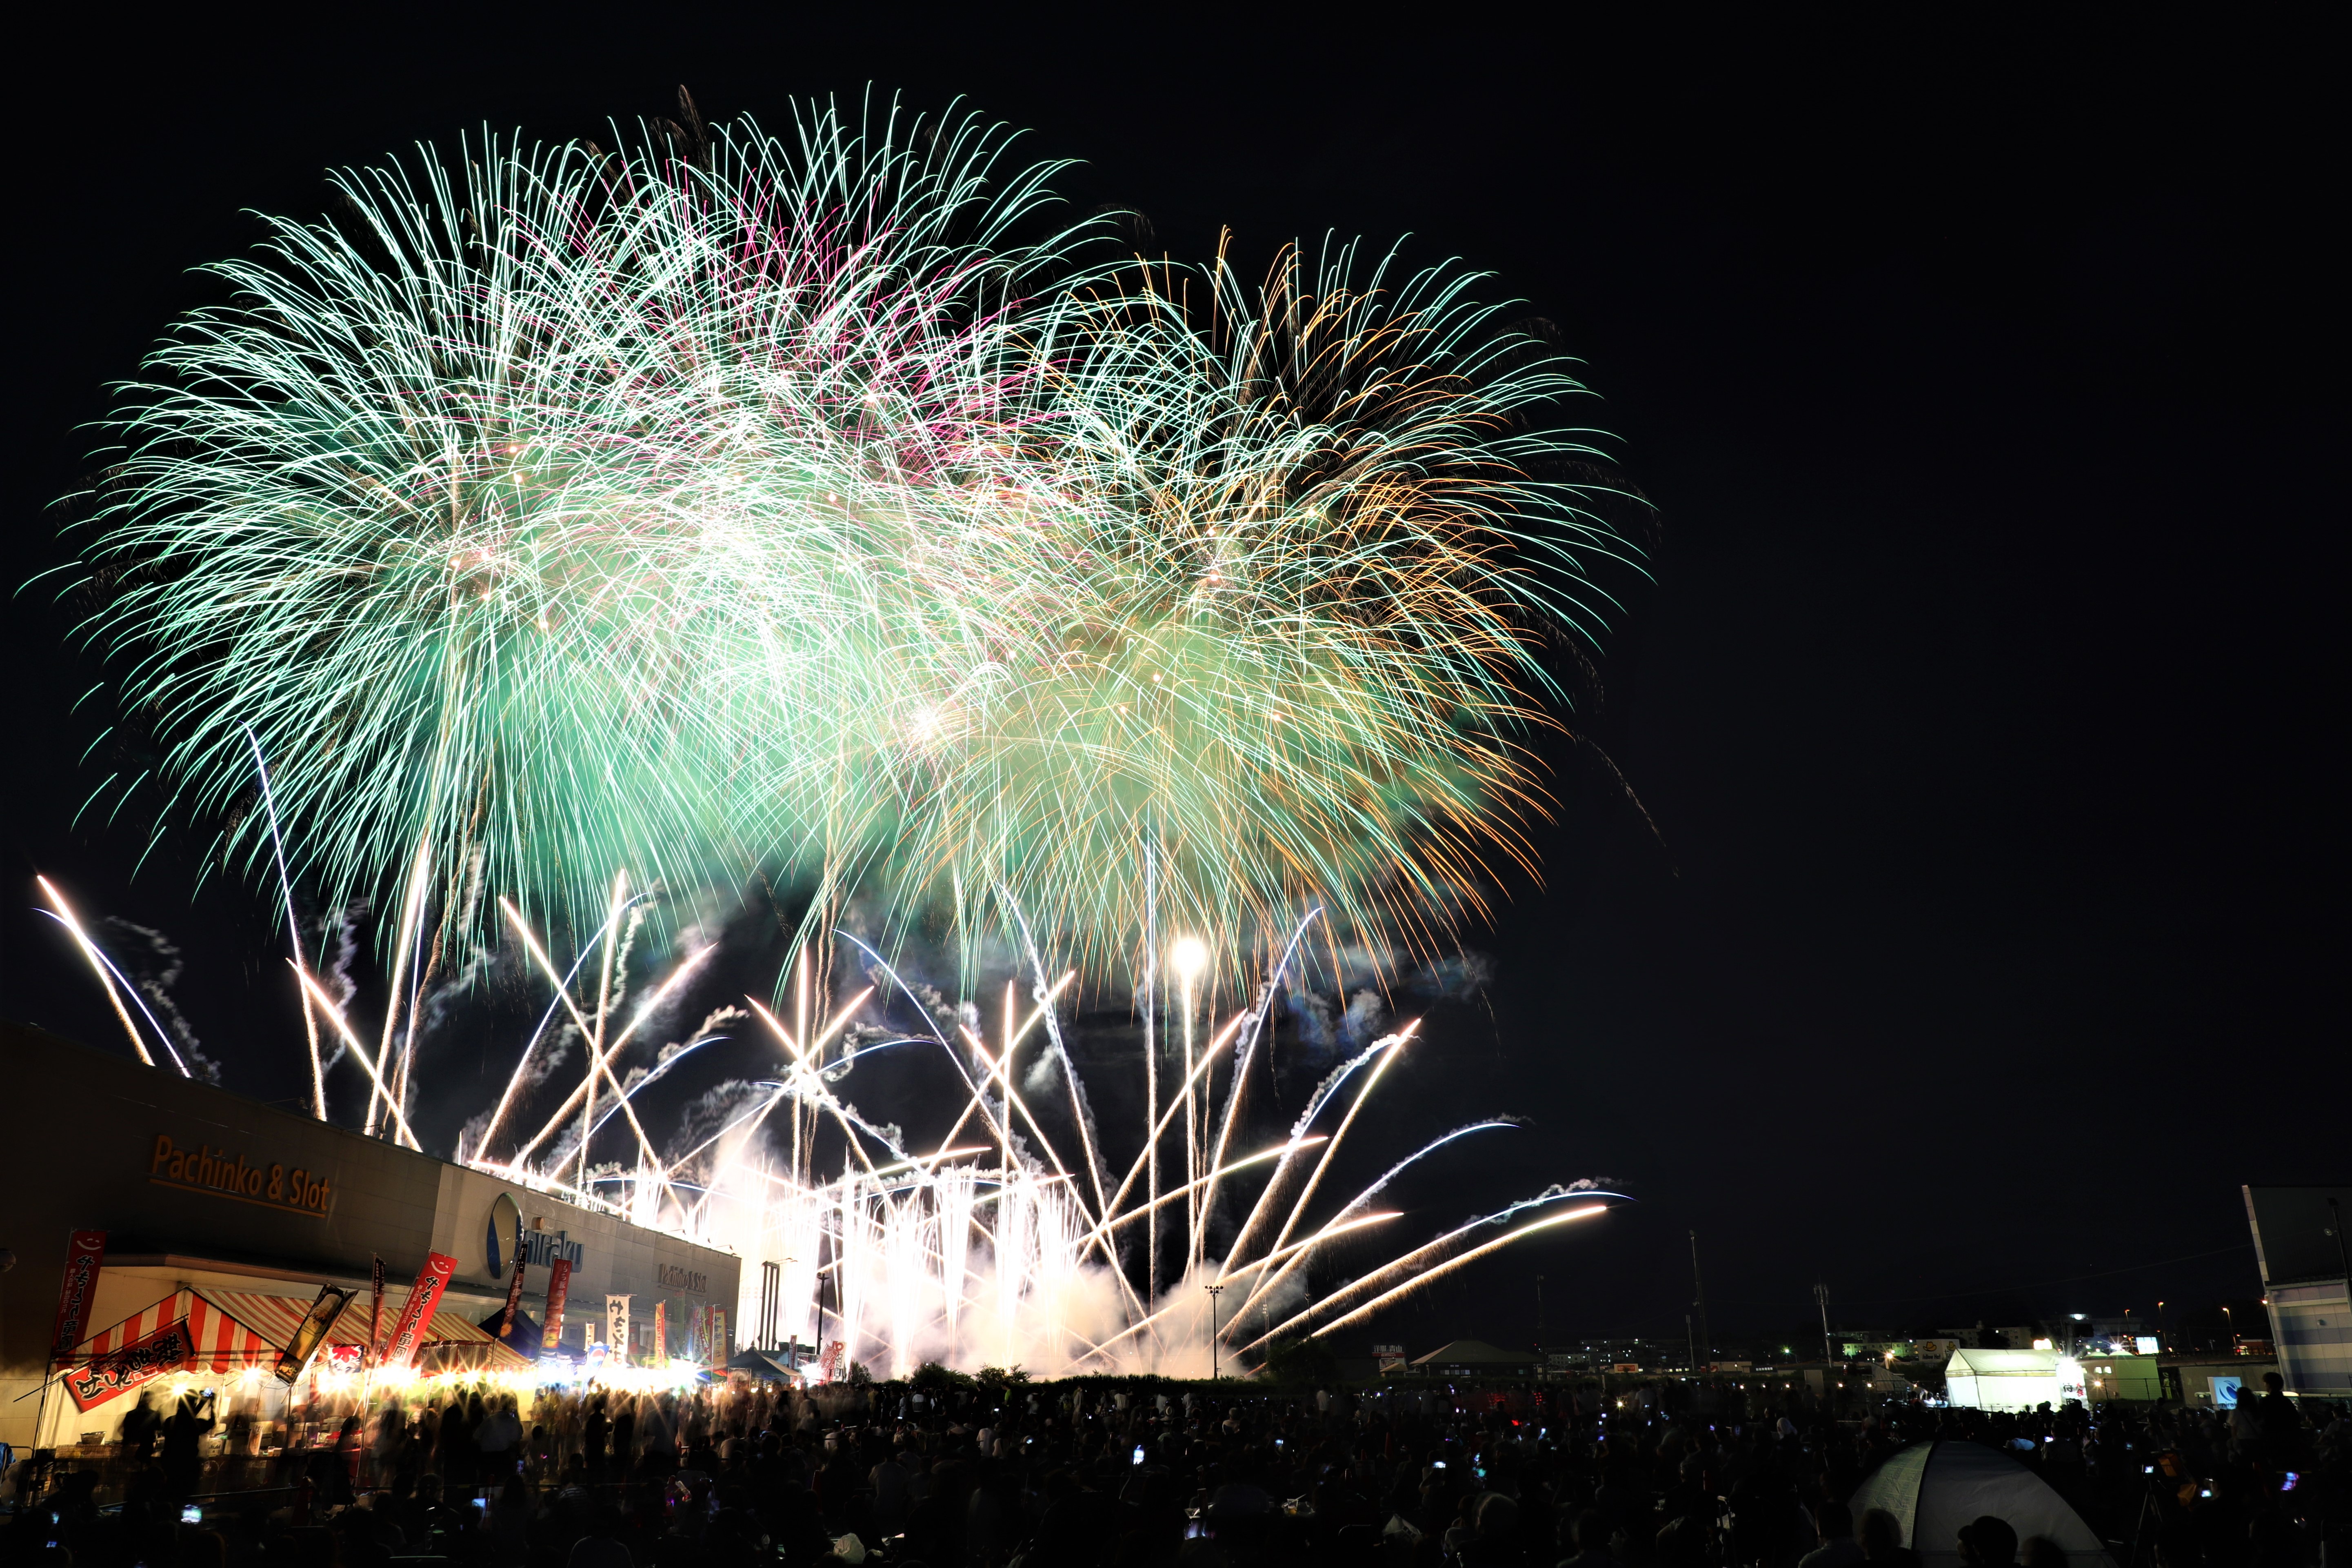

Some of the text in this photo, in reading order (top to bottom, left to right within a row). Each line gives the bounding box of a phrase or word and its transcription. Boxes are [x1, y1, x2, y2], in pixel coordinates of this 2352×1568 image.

[153, 1135, 330, 1211] Pachinko & Slot
[522, 1217, 584, 1273] niraku
[659, 1264, 689, 1288] Pachinko
